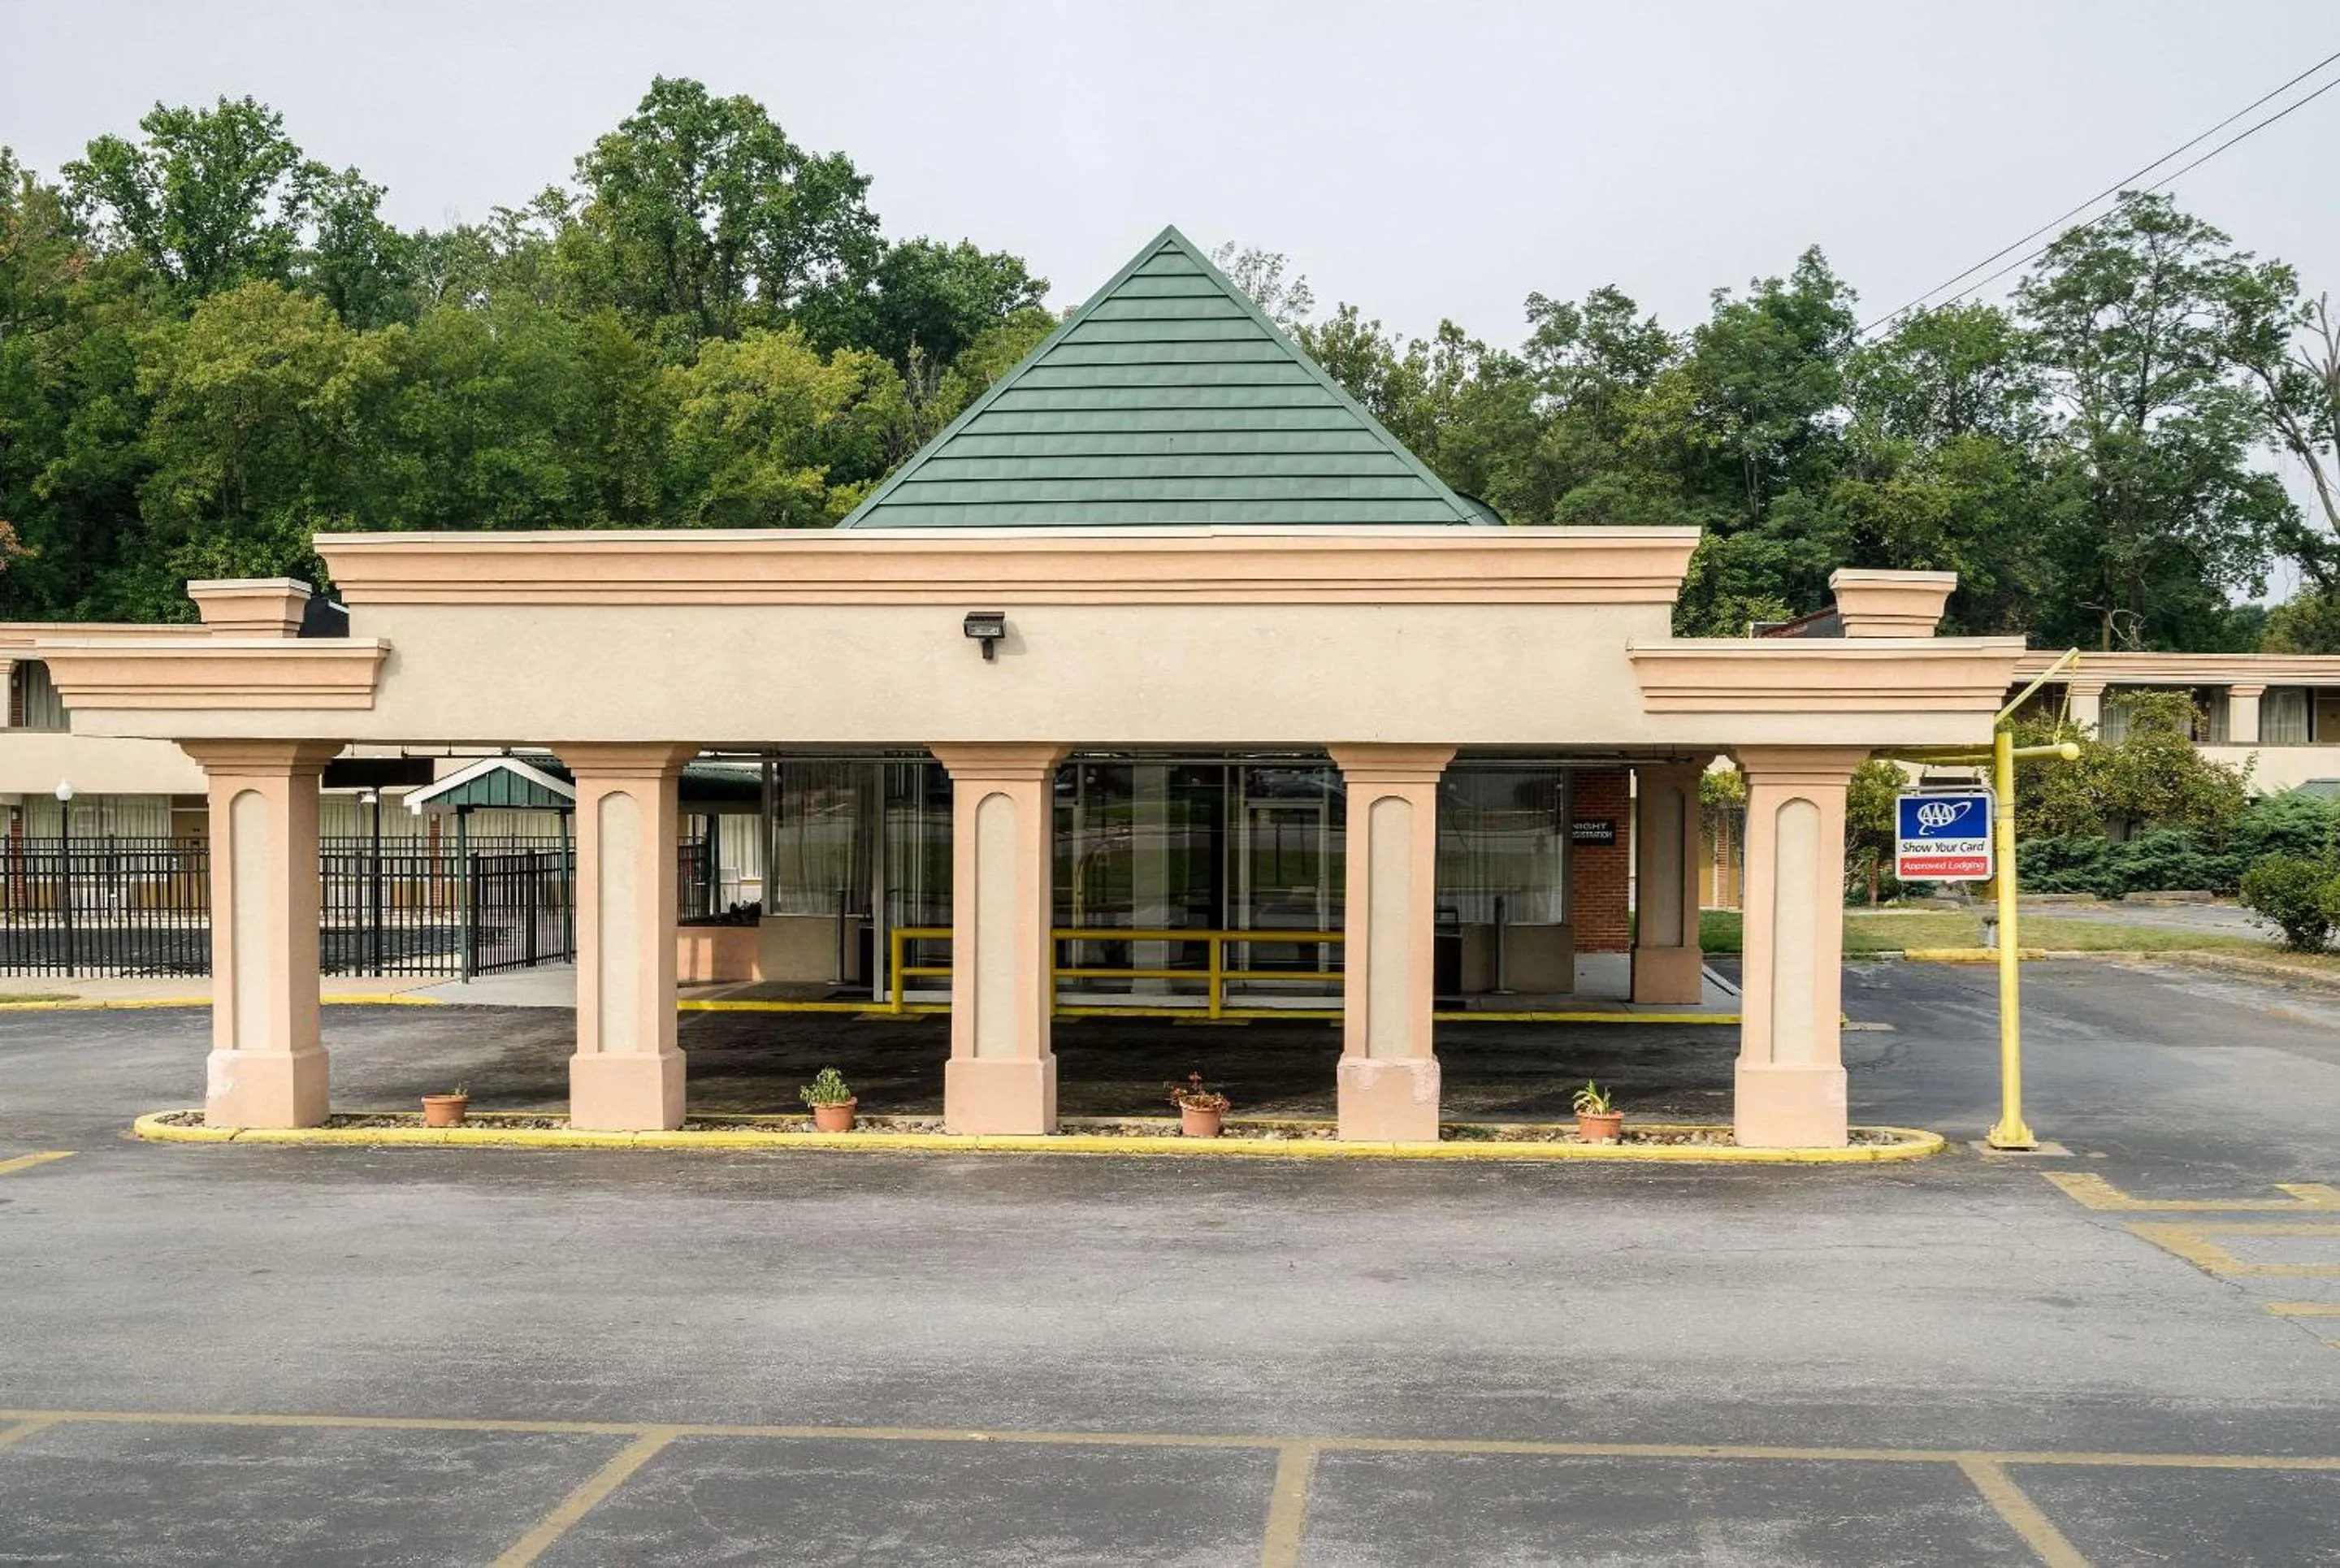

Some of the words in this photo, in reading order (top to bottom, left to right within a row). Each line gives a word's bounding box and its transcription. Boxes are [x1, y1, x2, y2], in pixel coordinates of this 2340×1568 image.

[1922, 803, 1955, 826] AAA
[1902, 842, 1932, 852] Show
[1935, 842, 1956, 852] Your
[1960, 841, 1985, 851] Card
[1903, 862, 1946, 870] Approved
[1948, 861, 1985, 870] Lodging
